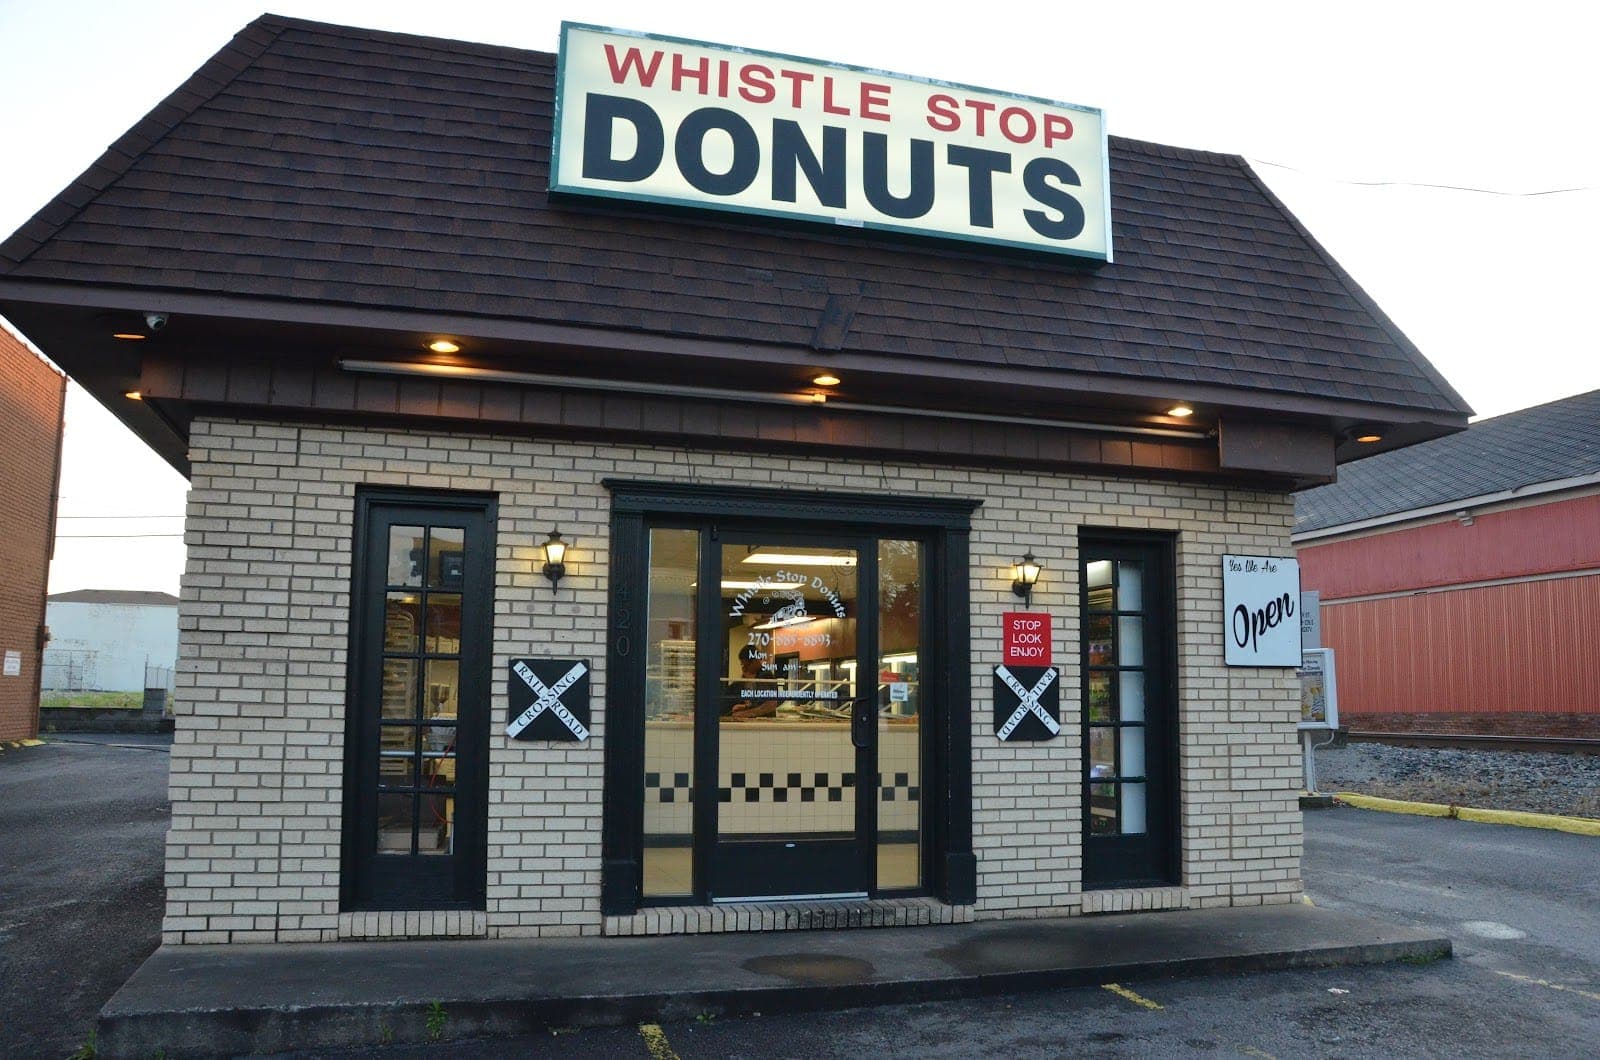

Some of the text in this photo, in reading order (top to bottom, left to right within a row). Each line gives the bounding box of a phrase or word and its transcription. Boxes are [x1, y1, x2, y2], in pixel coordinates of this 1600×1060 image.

[603, 44, 1074, 149] WHISTLE STOP
[581, 92, 1086, 241] DONUTS
[1229, 559, 1277, 573] Yes We Are
[776, 569, 807, 584] Stop
[811, 577, 846, 618] Donuts
[1012, 633, 1042, 644] LOOK
[1013, 620, 1041, 631] STOP
[1233, 592, 1295, 653] Open
[1010, 646, 1044, 657] ENJOY
[517, 673, 576, 727] CROSSING
[518, 666, 583, 735] RAIL ROAD
[740, 689, 753, 698] EACH
[754, 690, 777, 698] LOCATION
[1002, 672, 1054, 735] RAIL ROAD
[1006, 675, 1051, 725] CROSSING
